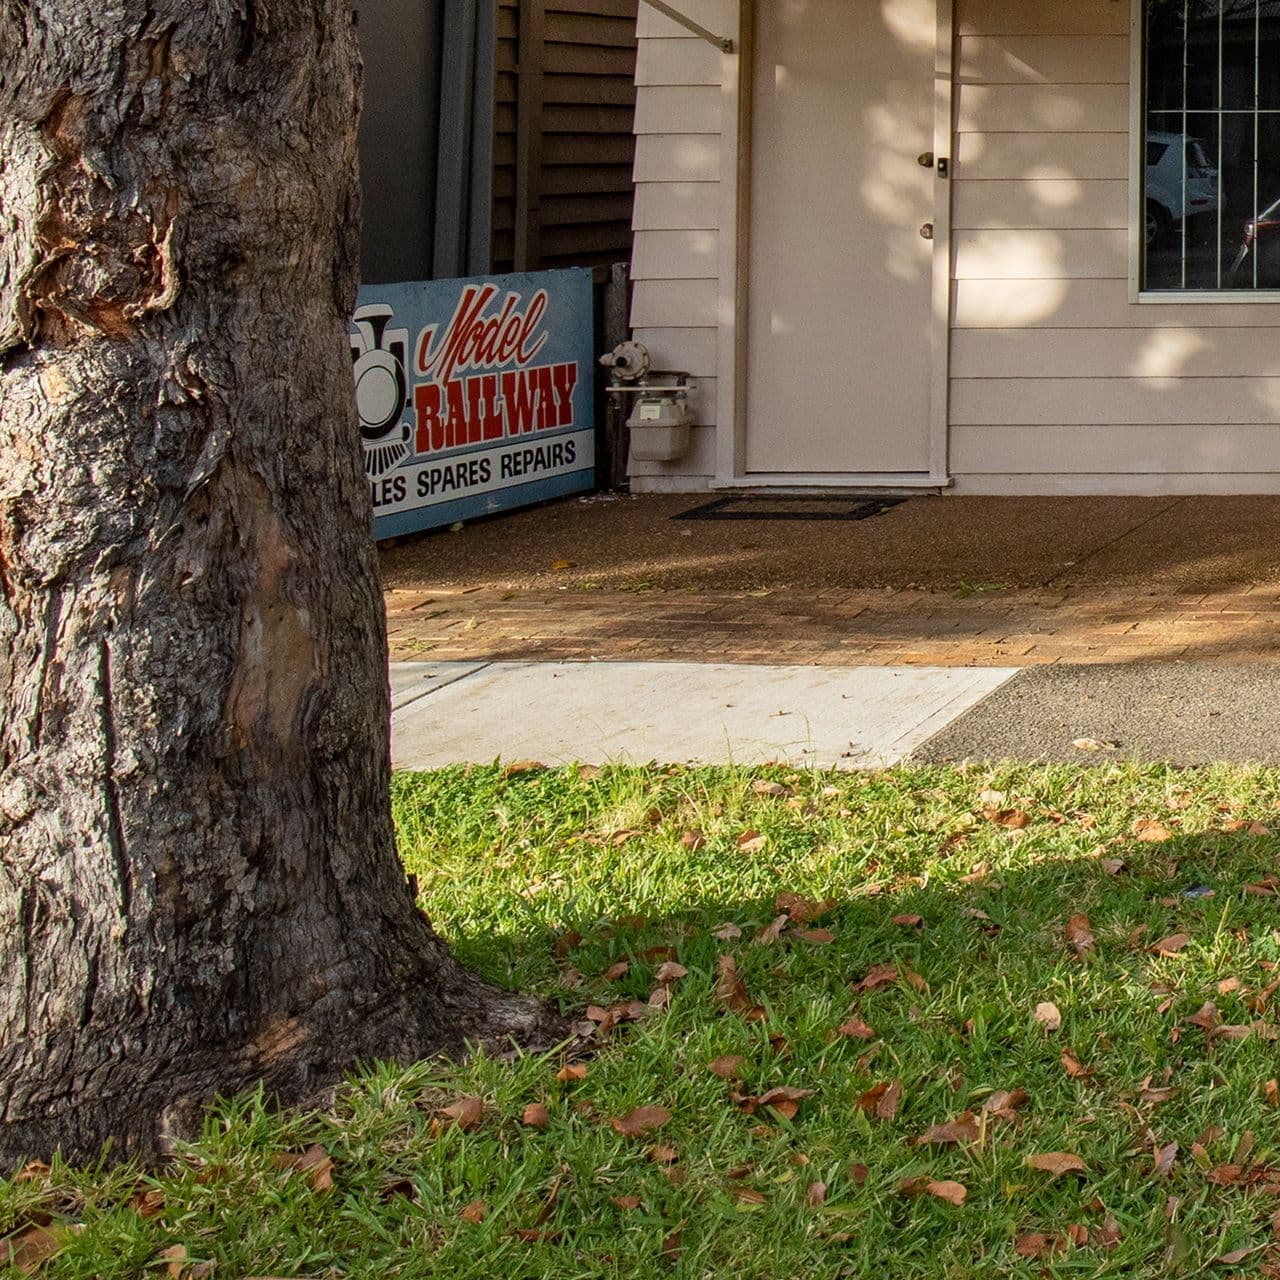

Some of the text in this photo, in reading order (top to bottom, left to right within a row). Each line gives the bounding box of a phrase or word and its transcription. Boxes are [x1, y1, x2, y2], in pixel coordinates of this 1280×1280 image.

[416, 284, 549, 382] Model
[414, 363, 577, 454] RAILWAY
[417, 458, 491, 498] SPARES
[500, 439, 577, 479] REPAIRS
